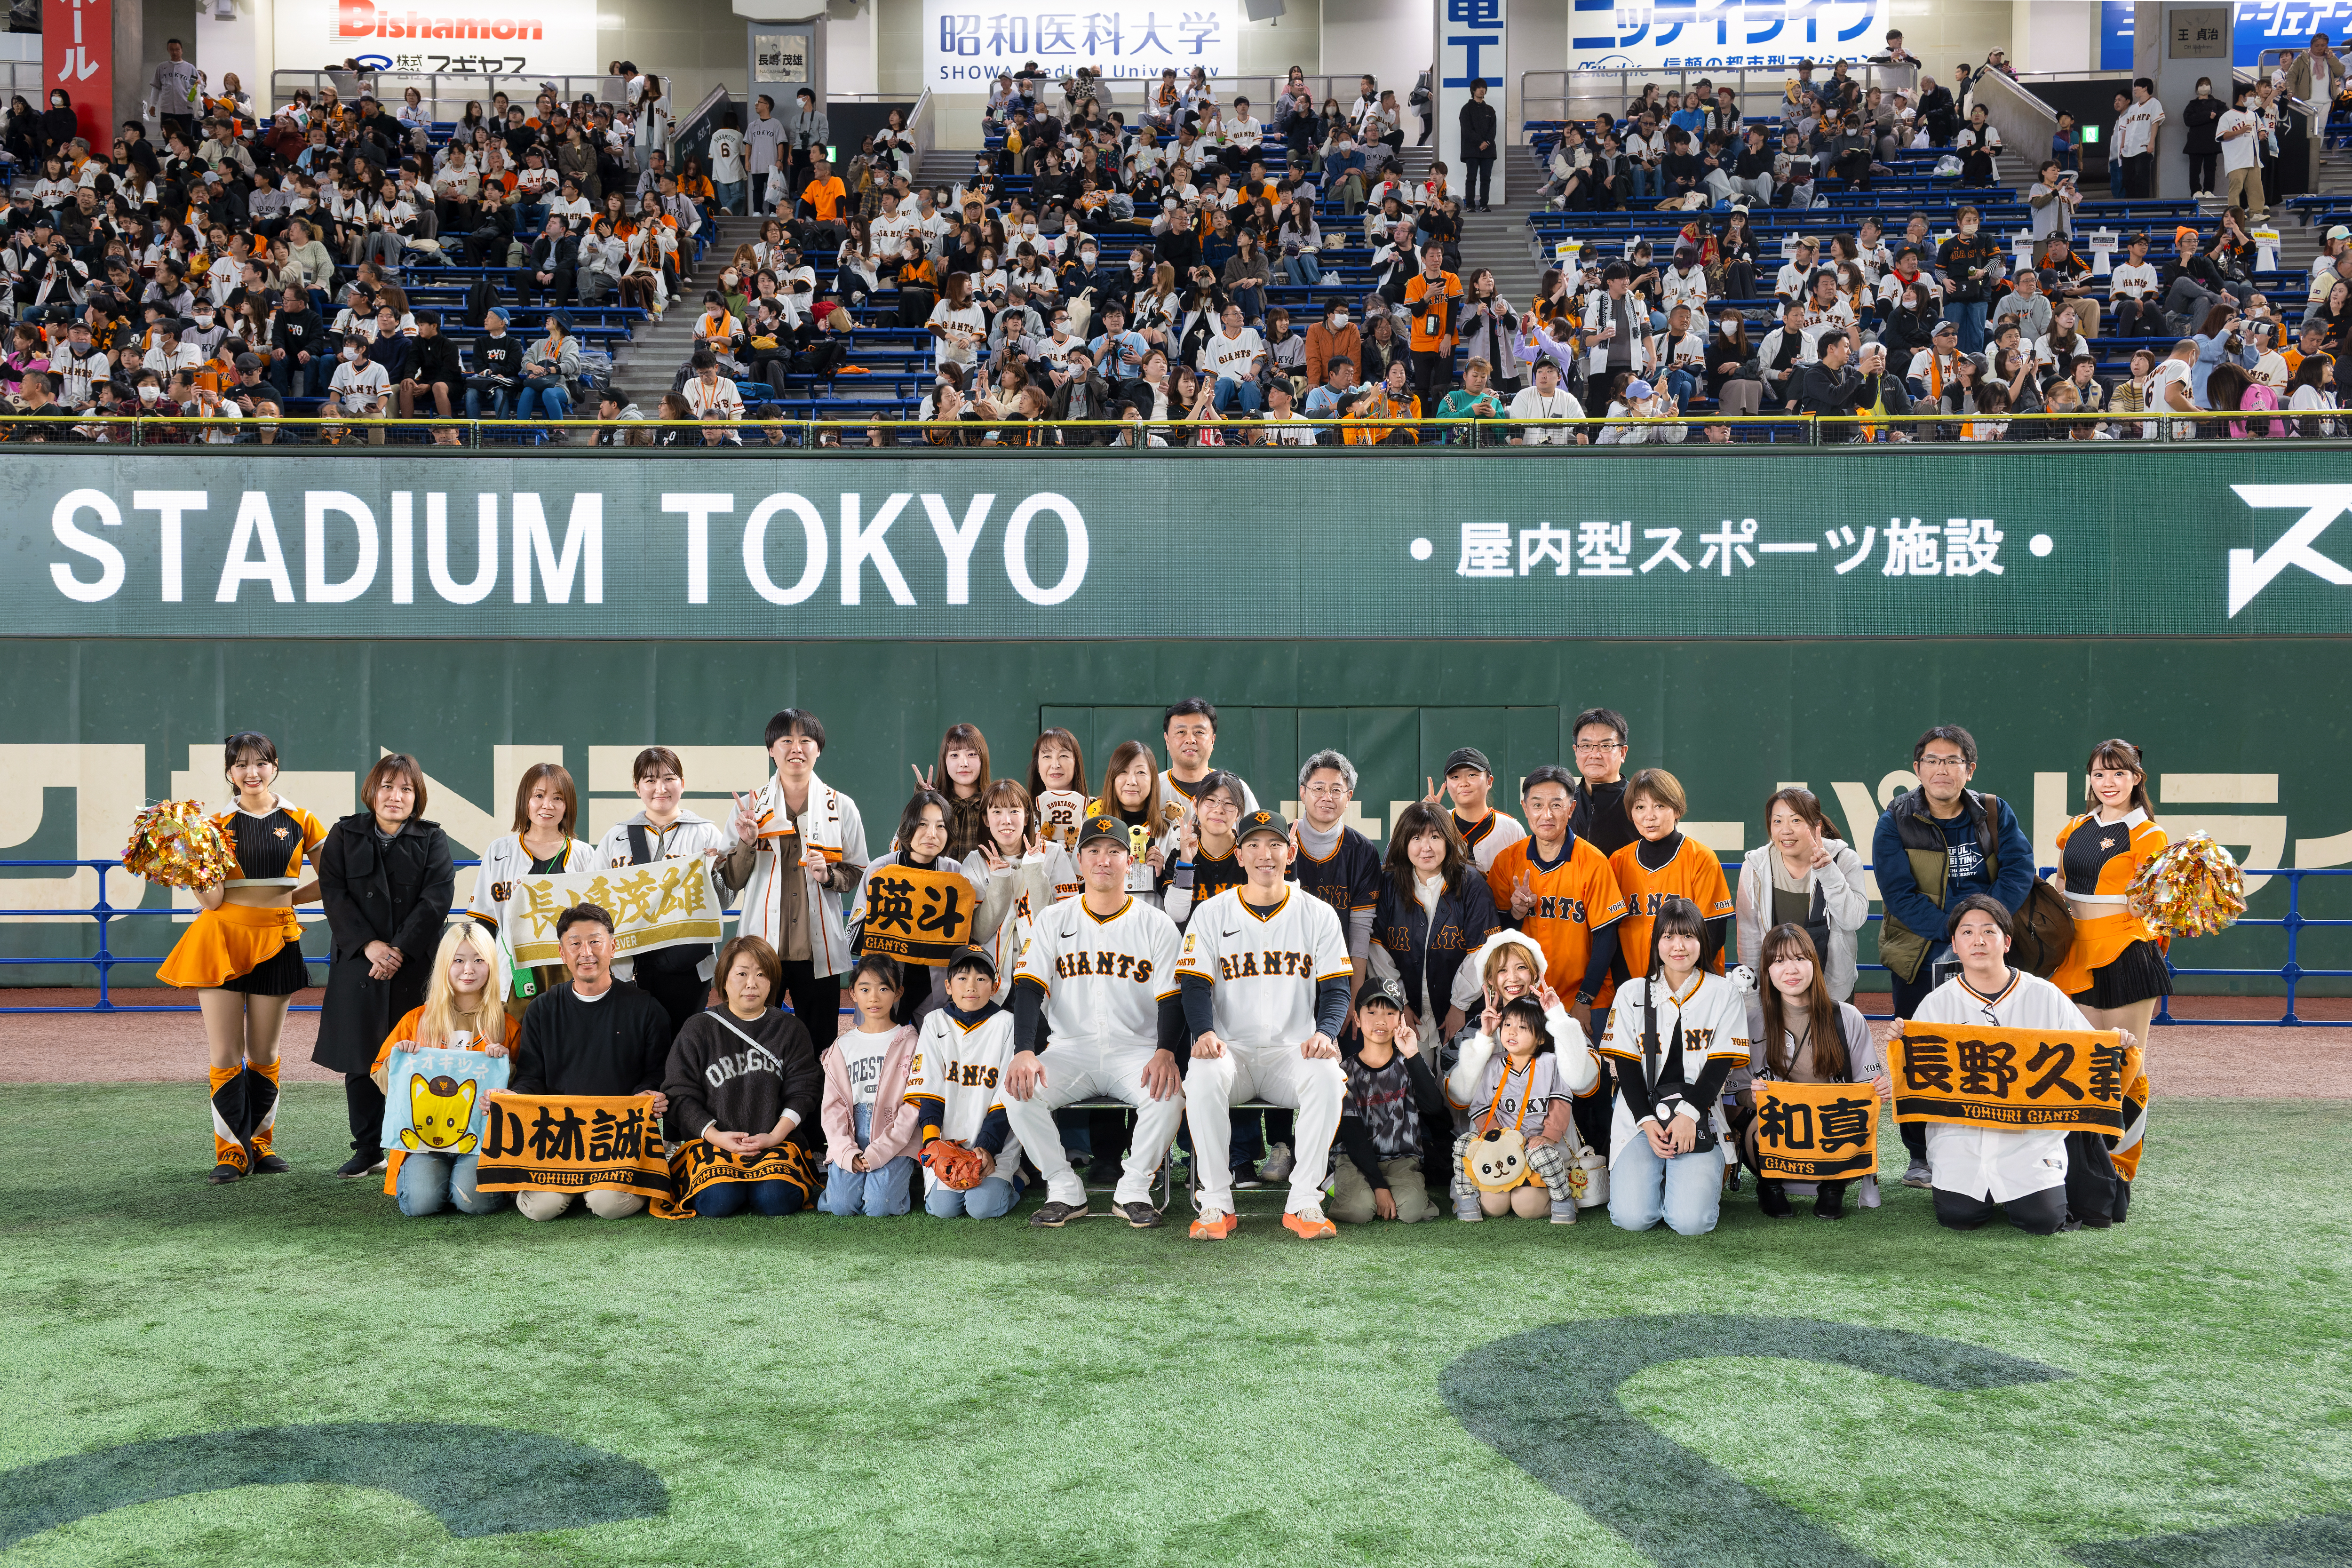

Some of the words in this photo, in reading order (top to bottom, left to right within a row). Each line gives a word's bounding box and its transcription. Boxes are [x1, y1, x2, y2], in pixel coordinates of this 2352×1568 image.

[339, 0, 542, 40] Bishamon
[57, 0, 99, 82] ール
[940, 12, 1220, 56] 昭和医科大学
[2178, 29, 2188, 40] 王
[2196, 28, 2218, 40] 貞治
[397, 54, 422, 67] 株式
[427, 56, 527, 81] スギヤス
[782, 54, 803, 65] 茂雄
[941, 66, 1012, 79] SHOWA
[656, 108, 667, 119] NTS
[721, 143, 730, 158] 6
[668, 209, 683, 218] KYO
[1428, 292, 1449, 305] ANTS
[942, 321, 974, 334] GIANTS
[1218, 349, 1251, 364] GIANTS
[2145, 380, 2156, 408] 6
[49, 488, 603, 605] STADIUM
[661, 492, 1089, 606] TOKYO
[1456, 517, 2005, 578] 屋内型スポーツ施設
[1047, 801, 1078, 811] KOBAYASHI
[1052, 810, 1073, 825] 22
[865, 876, 965, 939] 瑛斗
[1528, 895, 1586, 923] ANTS
[865, 936, 909, 954] GIANTS
[1056, 950, 1153, 984] GIANTS
[1220, 950, 1313, 982] GIANTS
[404, 1053, 489, 1080] ナオキツネ
[945, 1060, 999, 1090] ANTS
[1961, 1104, 2022, 1122] YOMIURI
[2027, 1109, 2080, 1123] GIANTS
[1758, 1095, 1872, 1154] 和真
[1765, 1158, 1815, 1174] GIANTS
[529, 1170, 584, 1185] YOMIURI
[589, 1170, 634, 1184] GIANTS
[691, 1166, 740, 1189] YOMIURI
[744, 1164, 791, 1180] GIANTS
